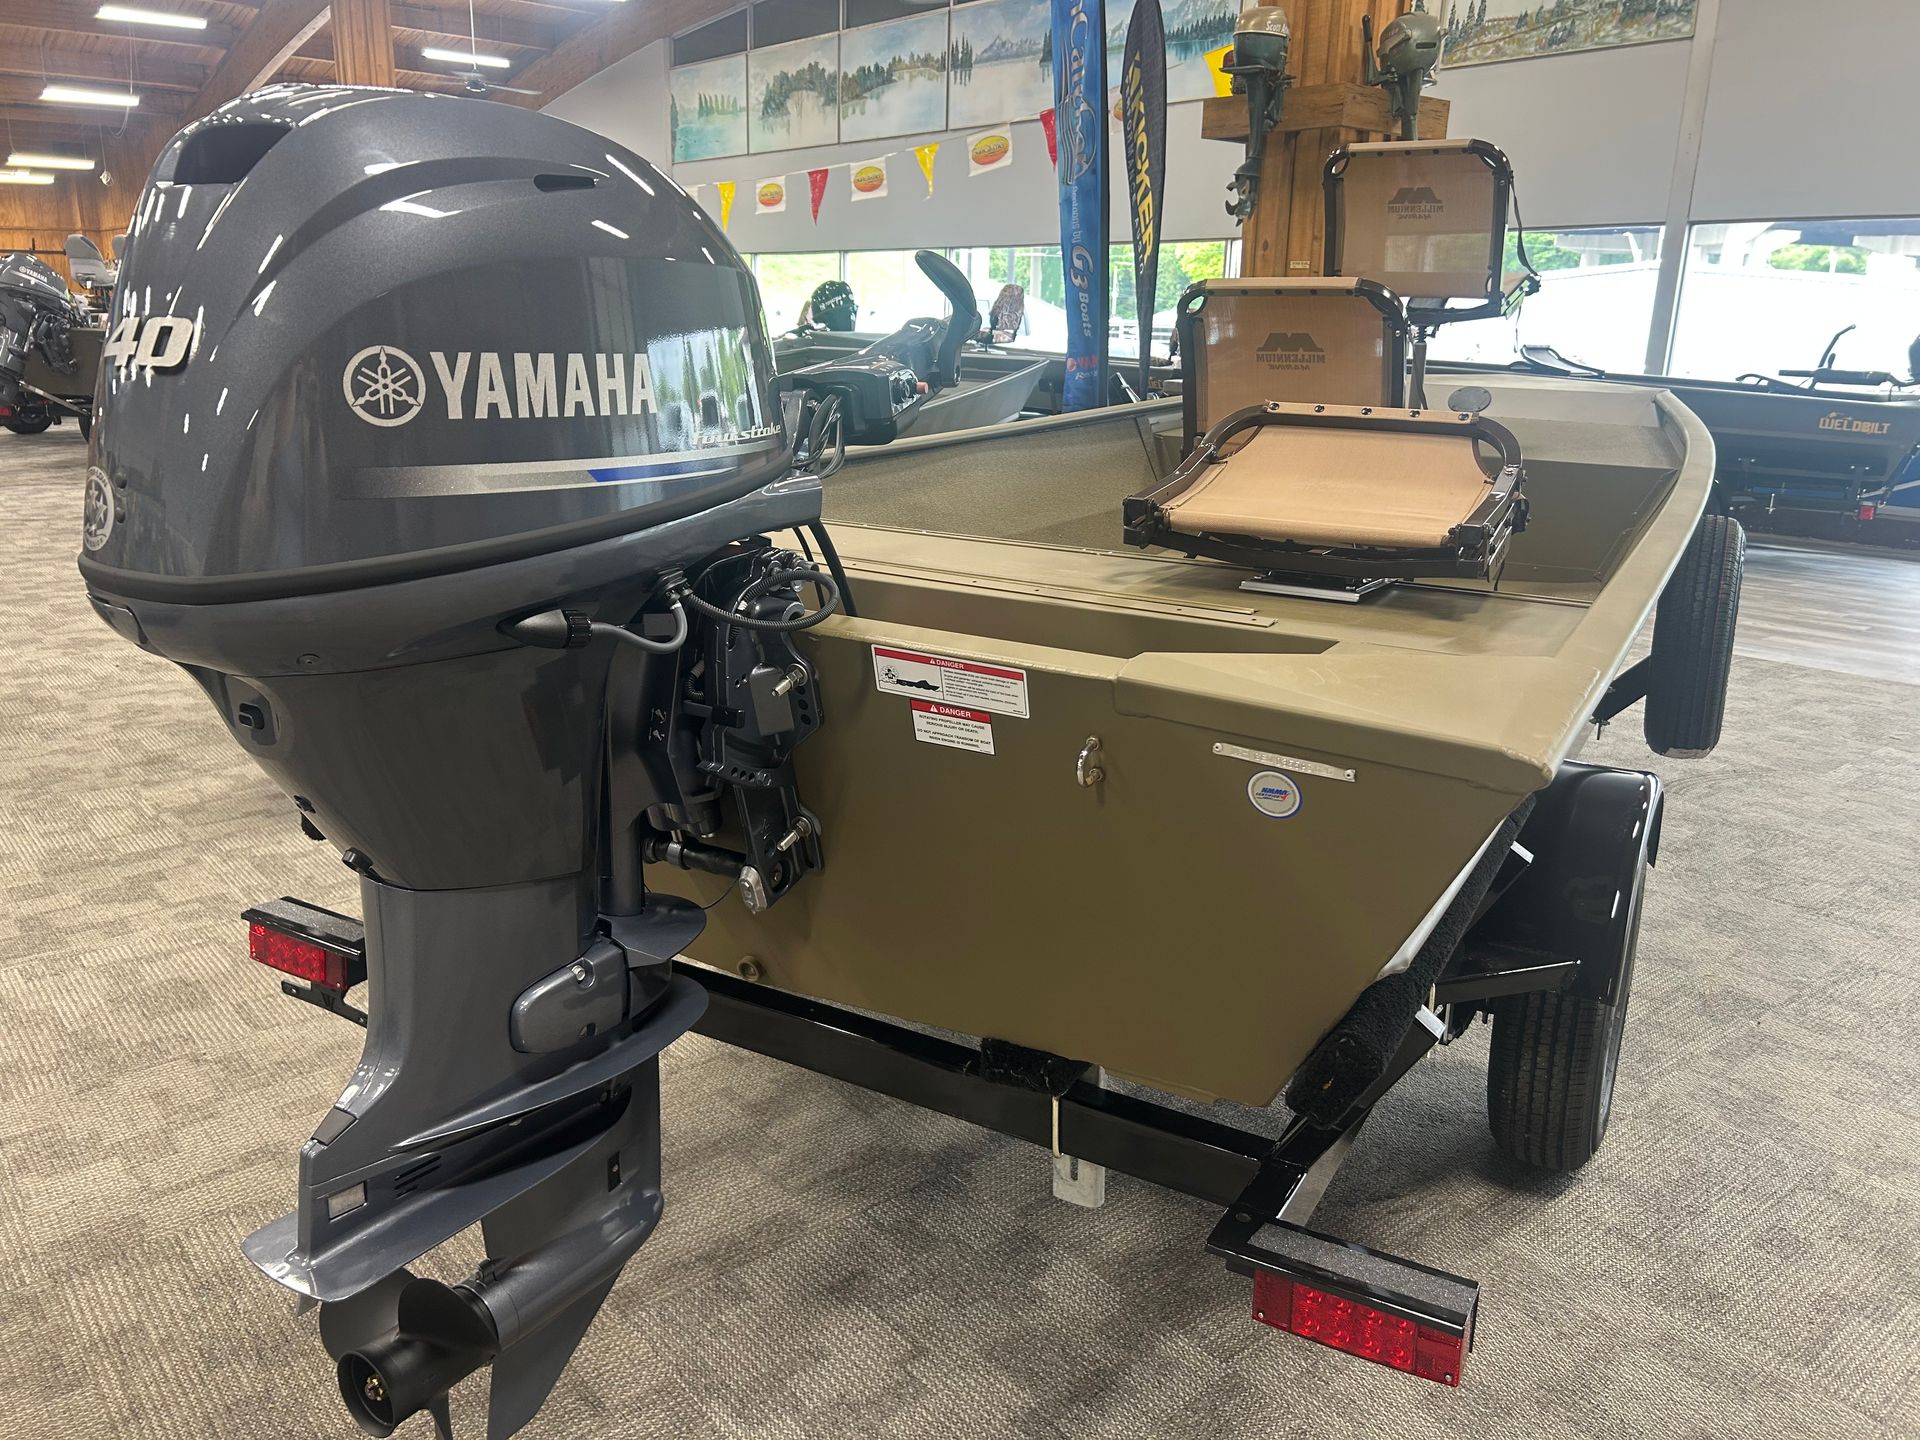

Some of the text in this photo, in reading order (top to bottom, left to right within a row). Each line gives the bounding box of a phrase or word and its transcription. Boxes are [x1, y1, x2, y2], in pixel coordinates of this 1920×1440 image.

[1131, 80, 1153, 265] KICKER
[25, 268, 48, 283] YAMAHA
[1070, 246, 1094, 290] G3
[1078, 292, 1092, 337] Boats
[103, 316, 194, 367] 40
[429, 351, 658, 420] YAMAHA
[1818, 416, 1891, 435] WELDBILT
[936, 660, 964, 669] DANGER
[939, 706, 971, 718] DANGER
